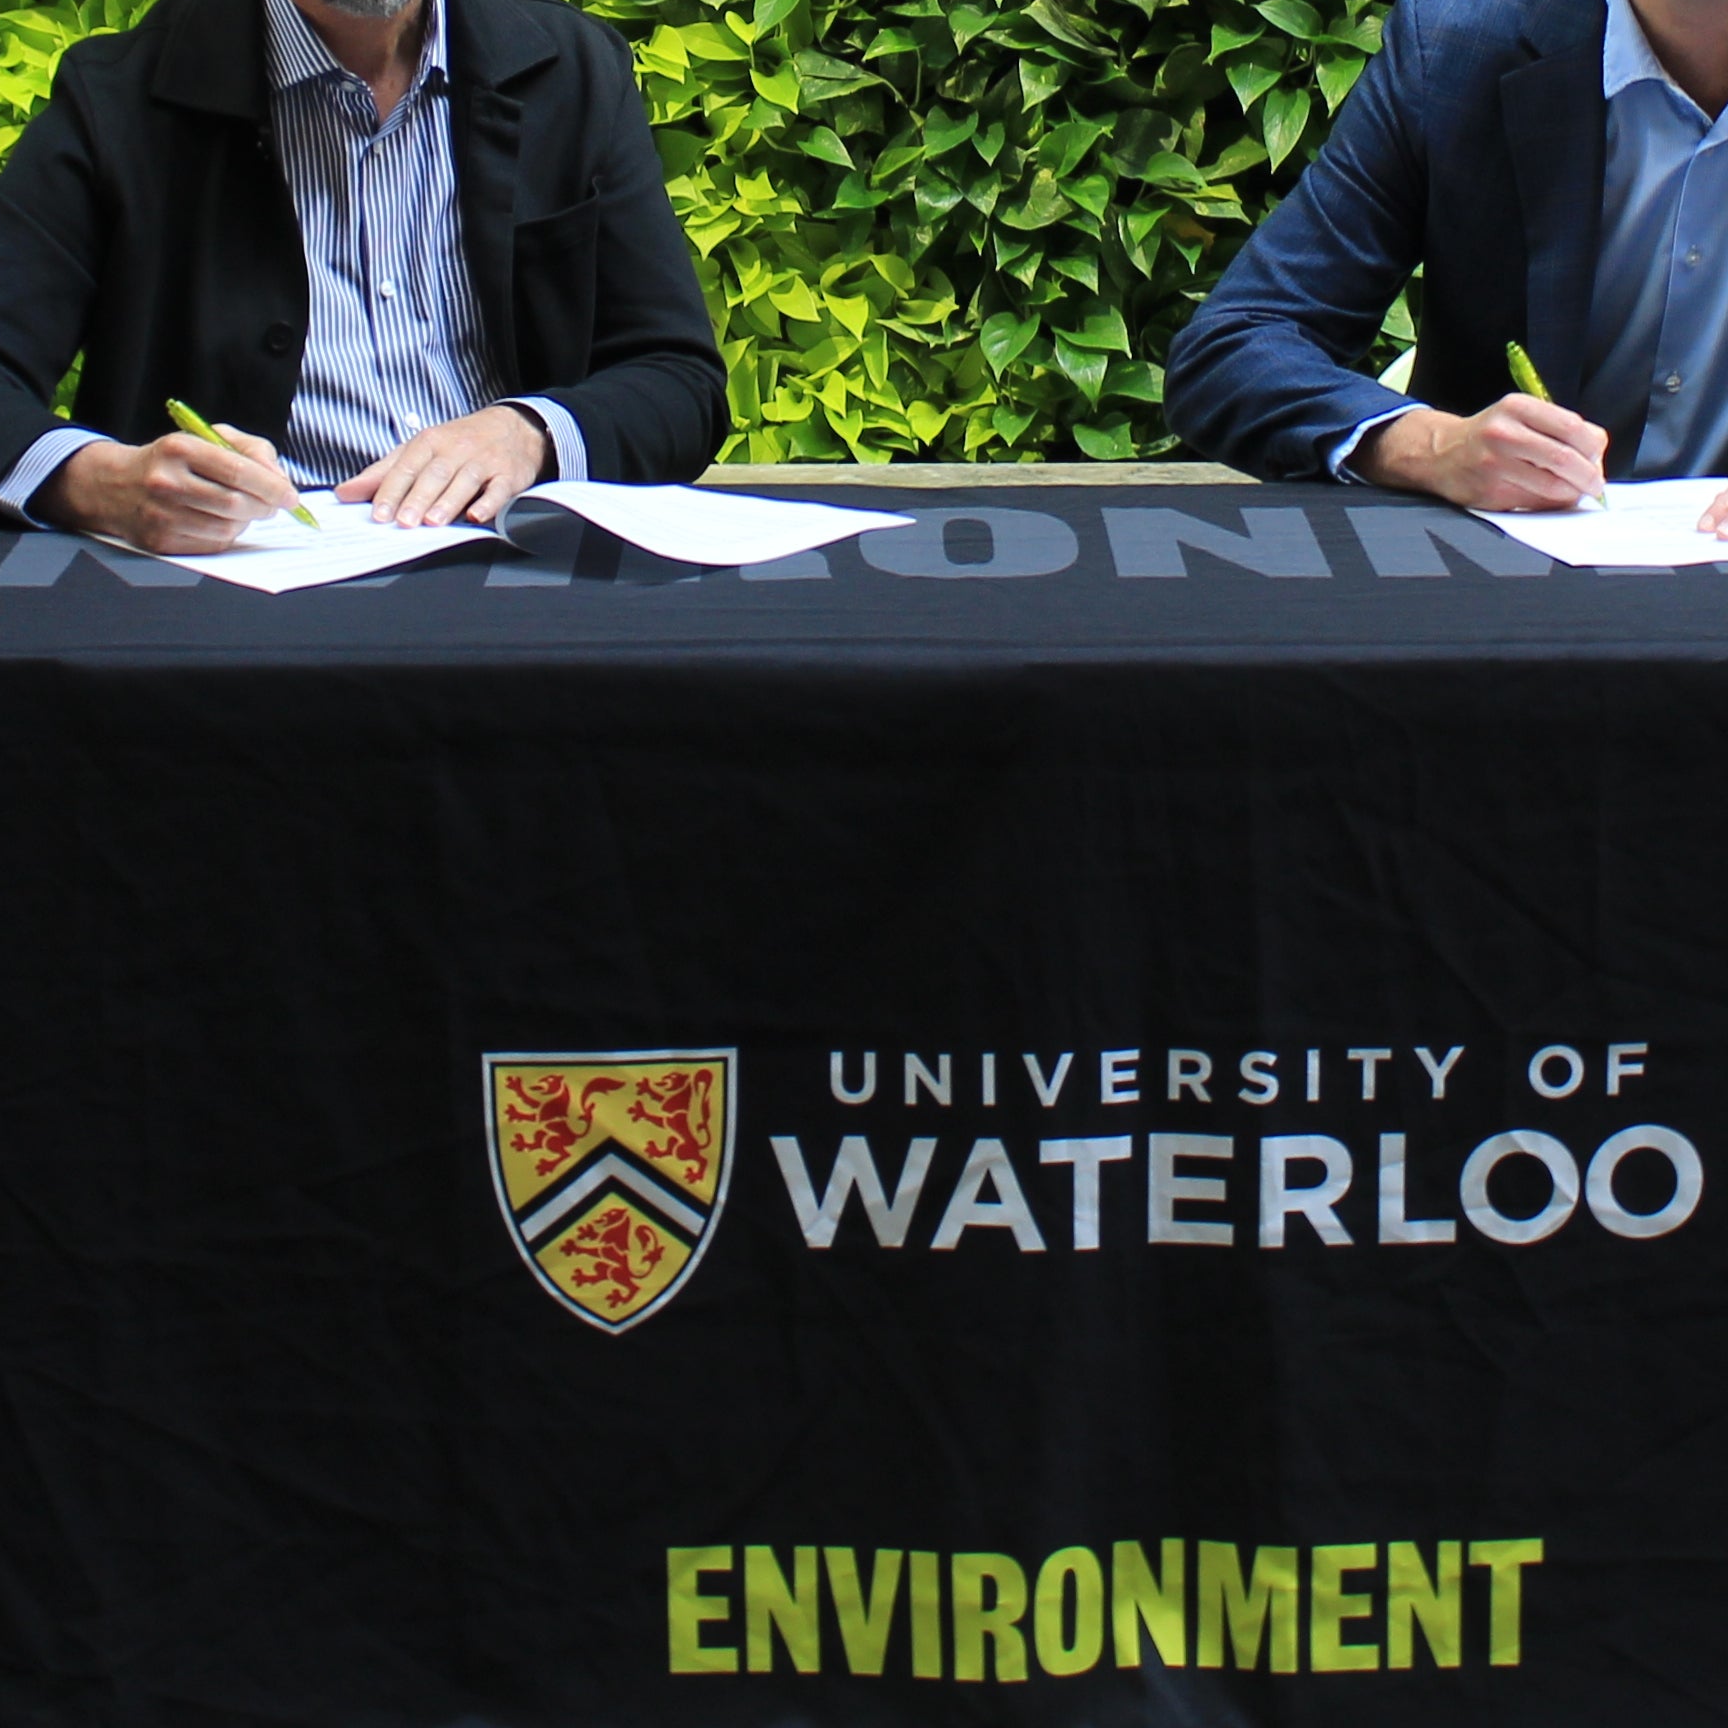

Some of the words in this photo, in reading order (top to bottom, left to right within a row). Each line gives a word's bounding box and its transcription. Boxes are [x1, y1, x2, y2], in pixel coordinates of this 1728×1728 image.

[829, 1043, 1465, 1108] UNIVERSITY
[1527, 1042, 1648, 1100] OF
[769, 1123, 1704, 1253] WATERLOO
[667, 1537, 1544, 1683] ENVIRONMENT
